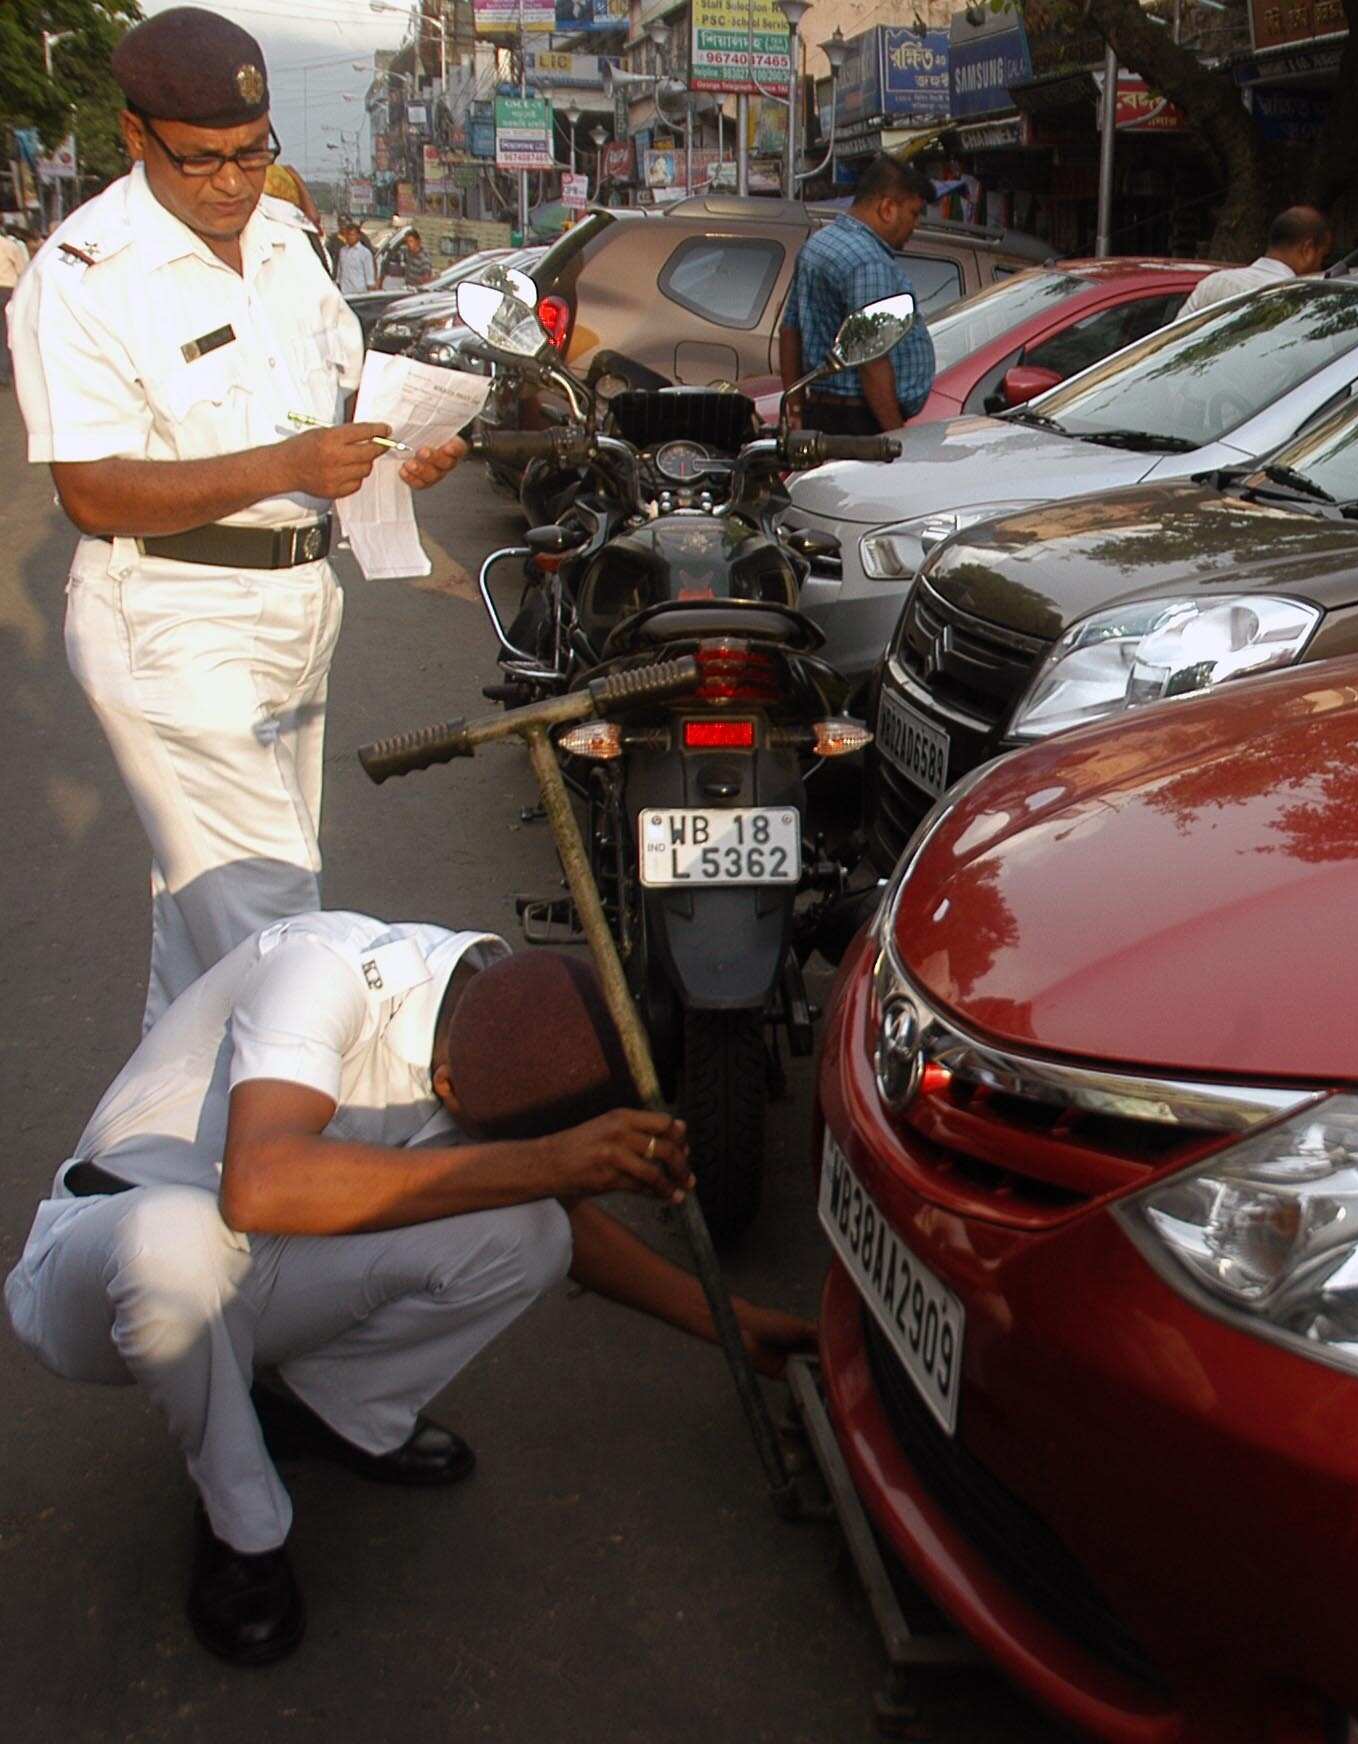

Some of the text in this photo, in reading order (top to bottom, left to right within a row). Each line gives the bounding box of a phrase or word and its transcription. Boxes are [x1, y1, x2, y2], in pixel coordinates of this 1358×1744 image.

[702, 15, 726, 26] PSC
[539, 55, 568, 68] LIC
[954, 57, 1004, 94] SAMSUNG
[669, 815, 769, 845] WB 18
[672, 846, 789, 879] L 5362
[830, 1142, 954, 1398] WB38AA2909
